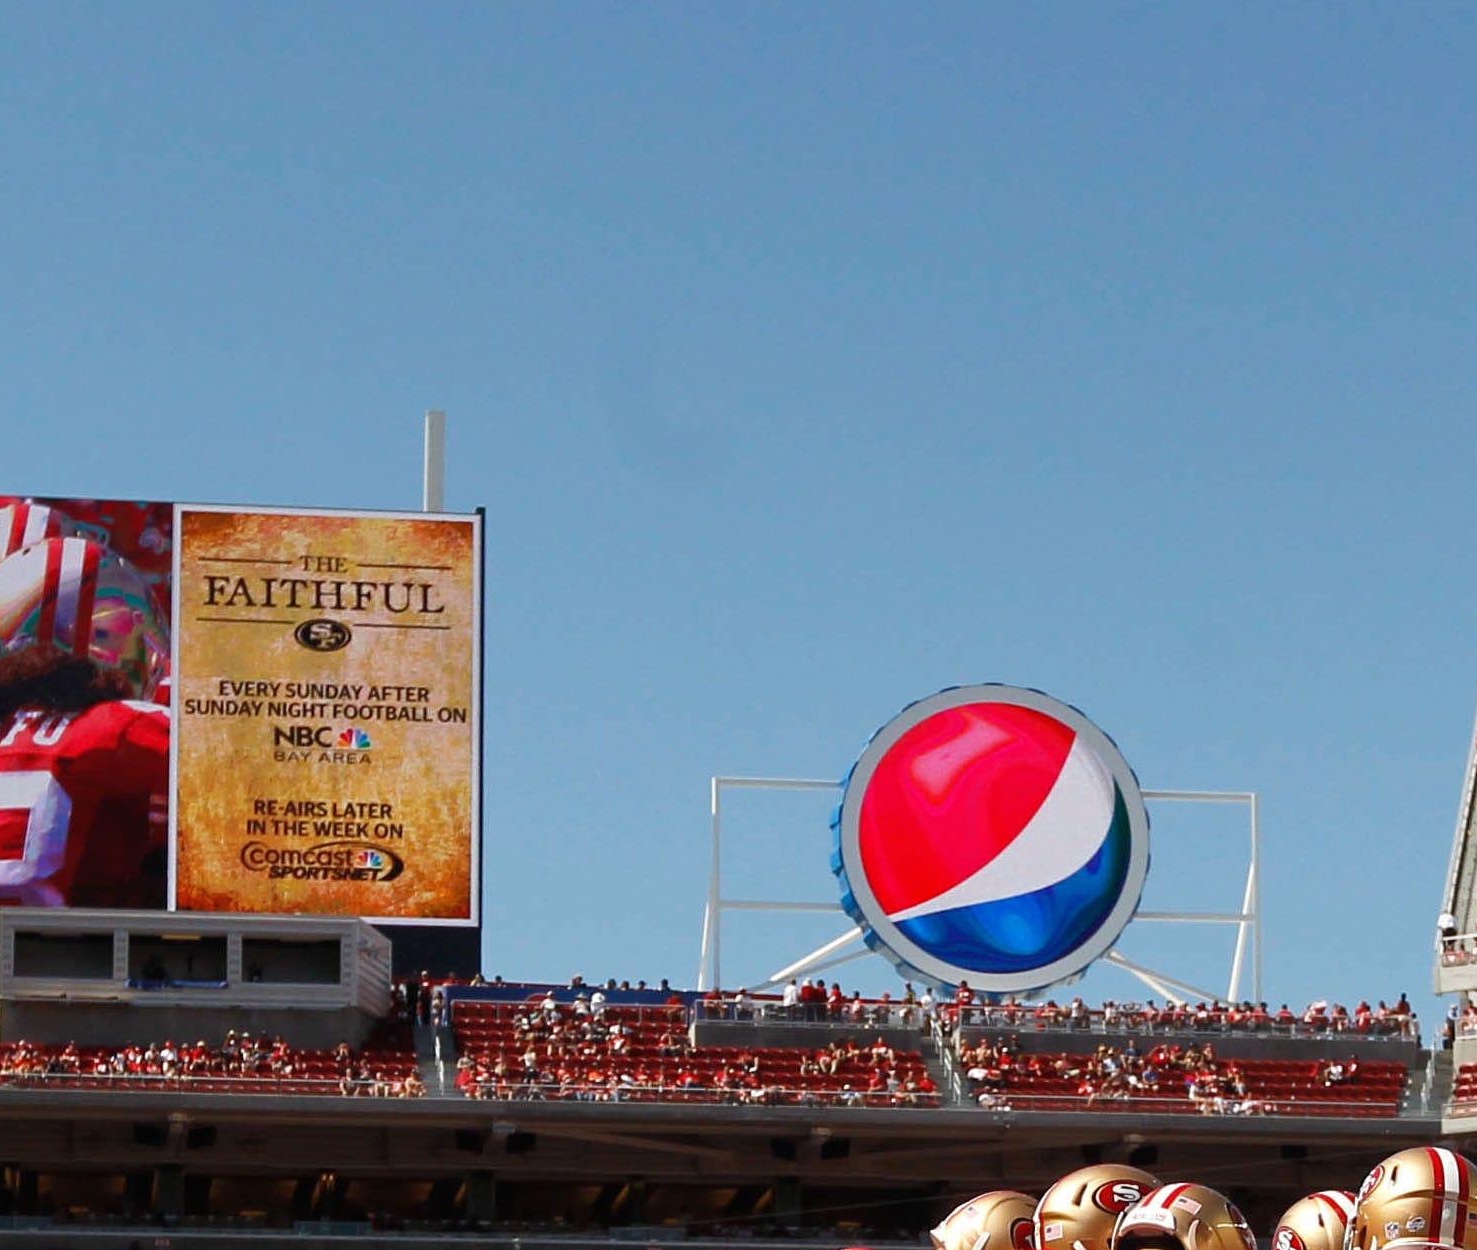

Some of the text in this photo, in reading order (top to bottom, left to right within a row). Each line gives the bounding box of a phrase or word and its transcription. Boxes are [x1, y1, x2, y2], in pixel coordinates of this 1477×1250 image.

[299, 555, 349, 574] THE
[202, 575, 446, 614] FAITHFUL
[219, 680, 430, 703] EVERY SUNDAY AFTER
[184, 699, 467, 724] SUNDAY NIGHT FOOTBALL ON
[273, 725, 333, 748] NBC
[274, 751, 371, 765] BAY AREA
[254, 799, 393, 819] RE-AIRS LATER
[246, 818, 404, 839] IN THE WEEK ON
